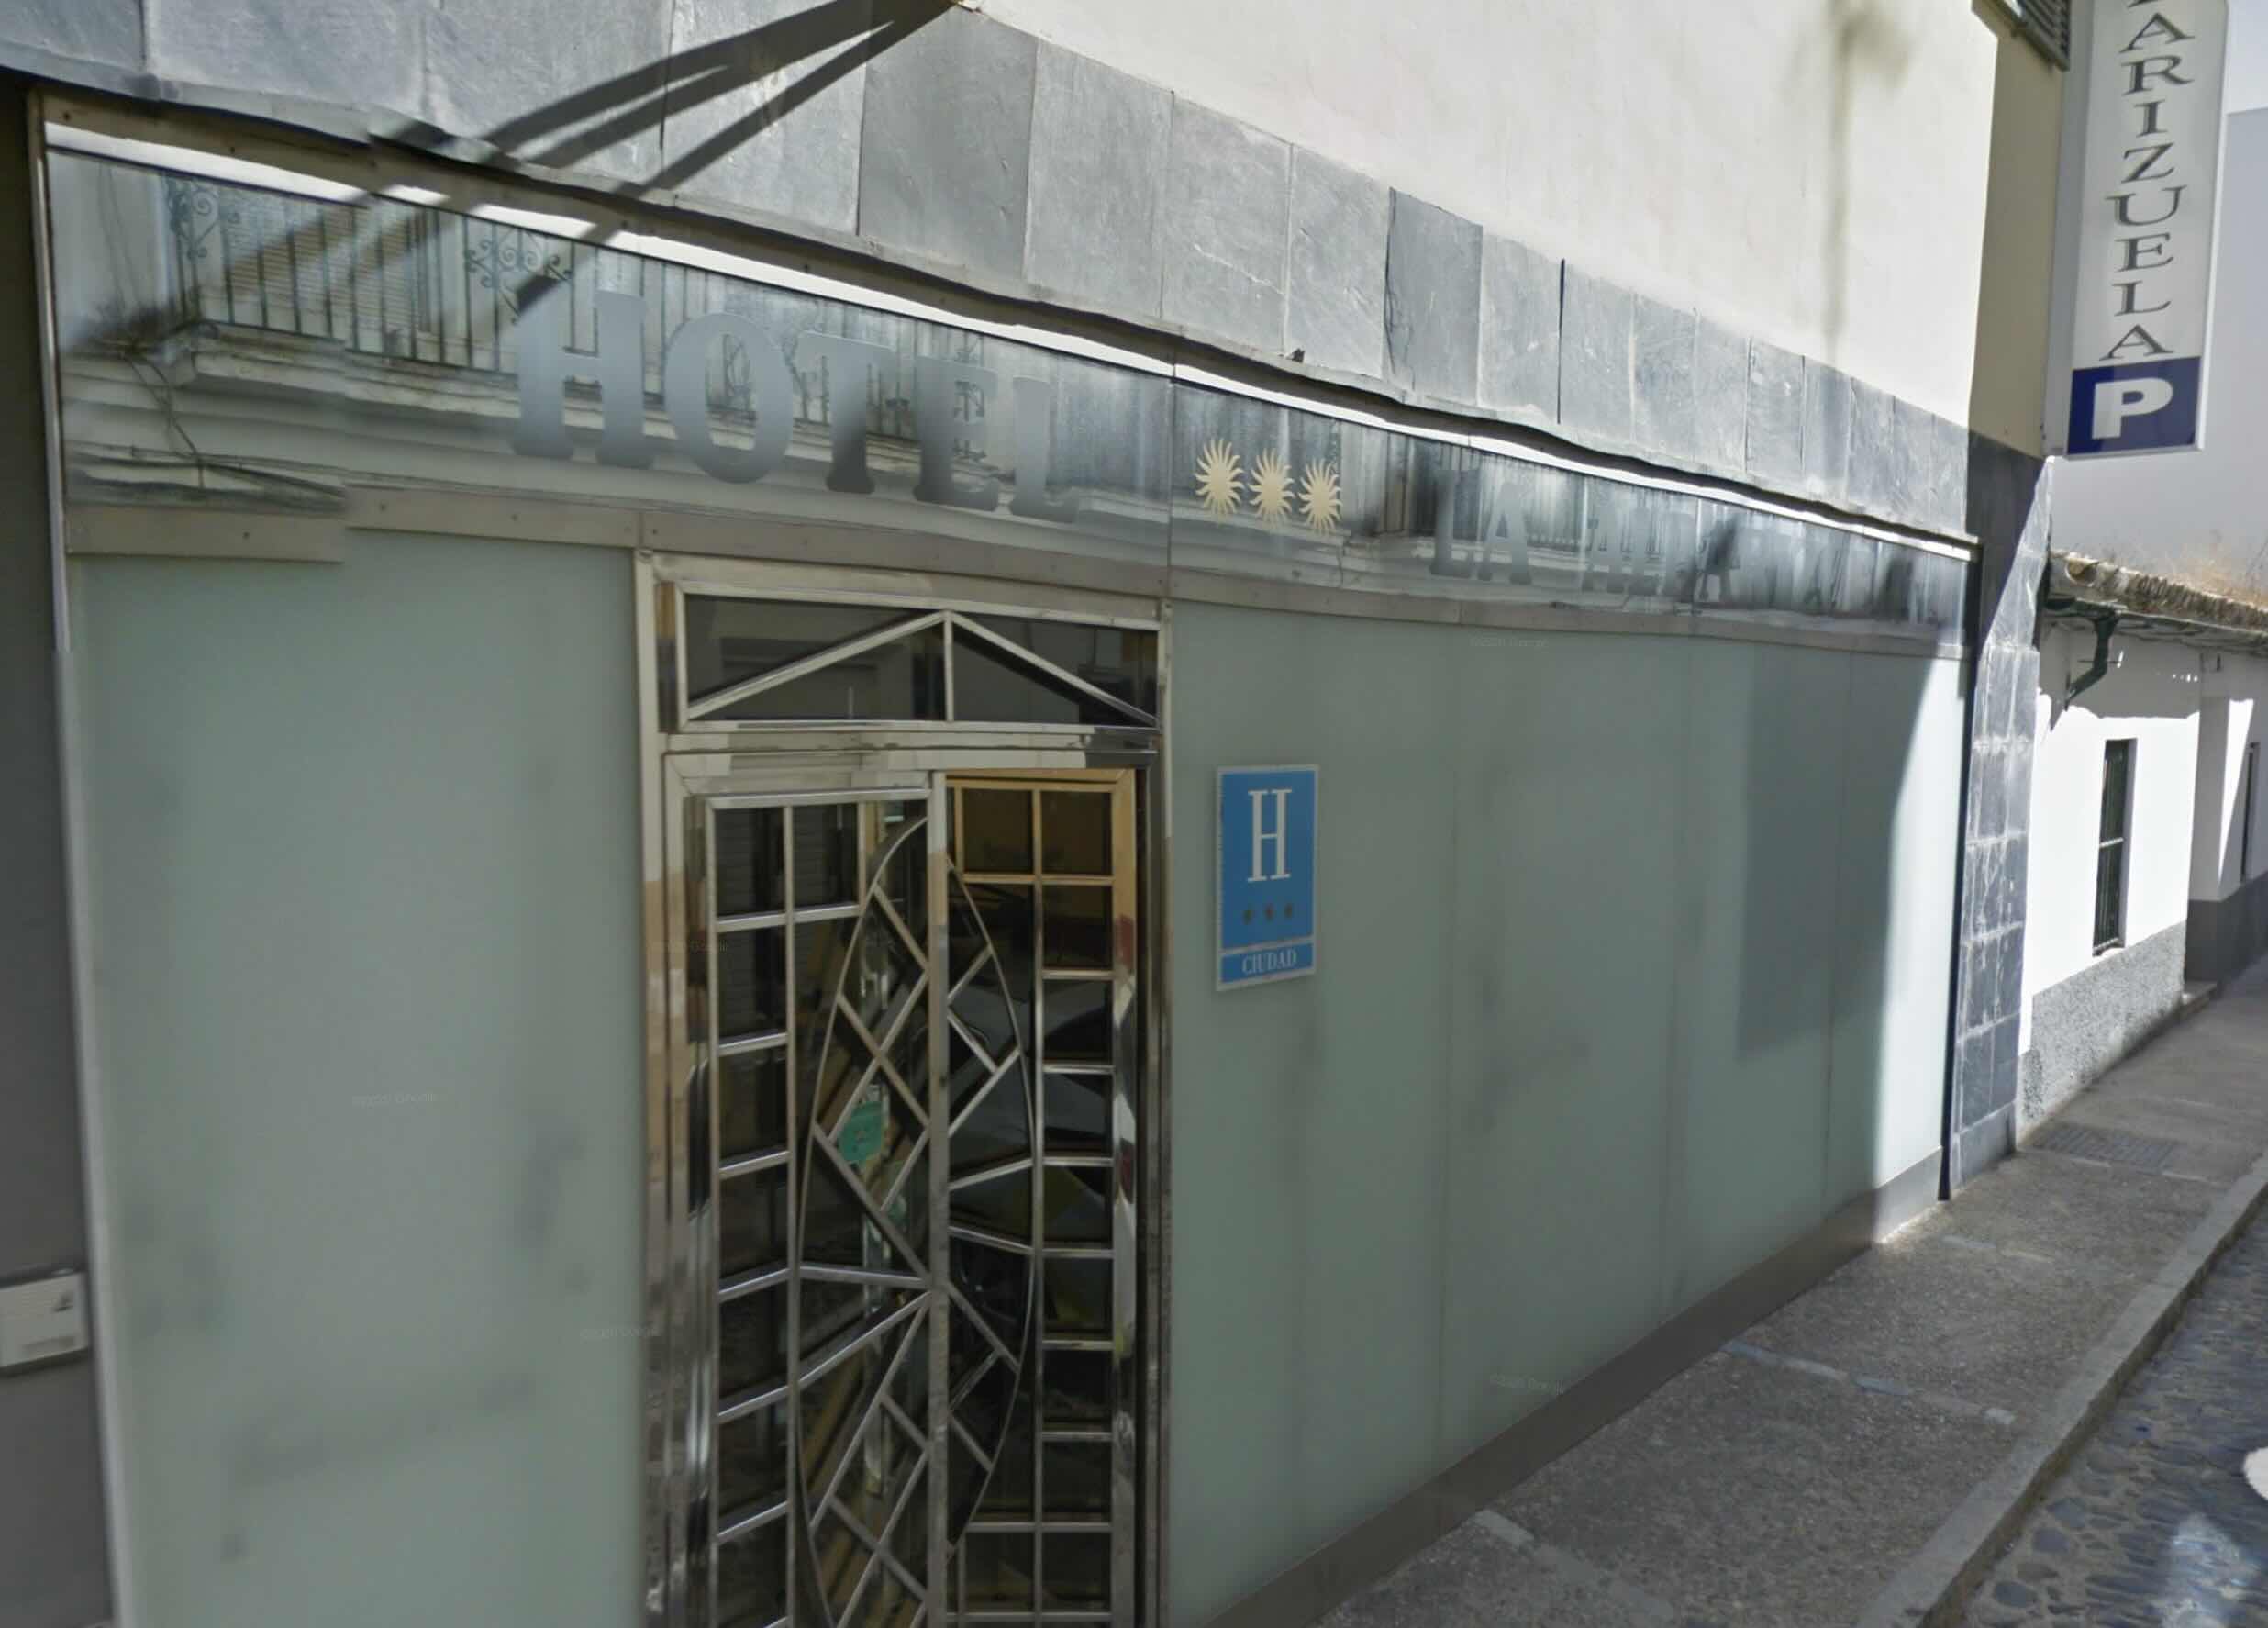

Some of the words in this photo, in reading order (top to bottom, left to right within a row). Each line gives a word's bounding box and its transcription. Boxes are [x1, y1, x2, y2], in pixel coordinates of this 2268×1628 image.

[2099, 0, 2196, 362] ARIZUELA
[509, 281, 1082, 524] HOTEL
[2090, 377, 2174, 440] P
[1247, 788, 1293, 883] H
[1241, 949, 1297, 975] CIUDAD
